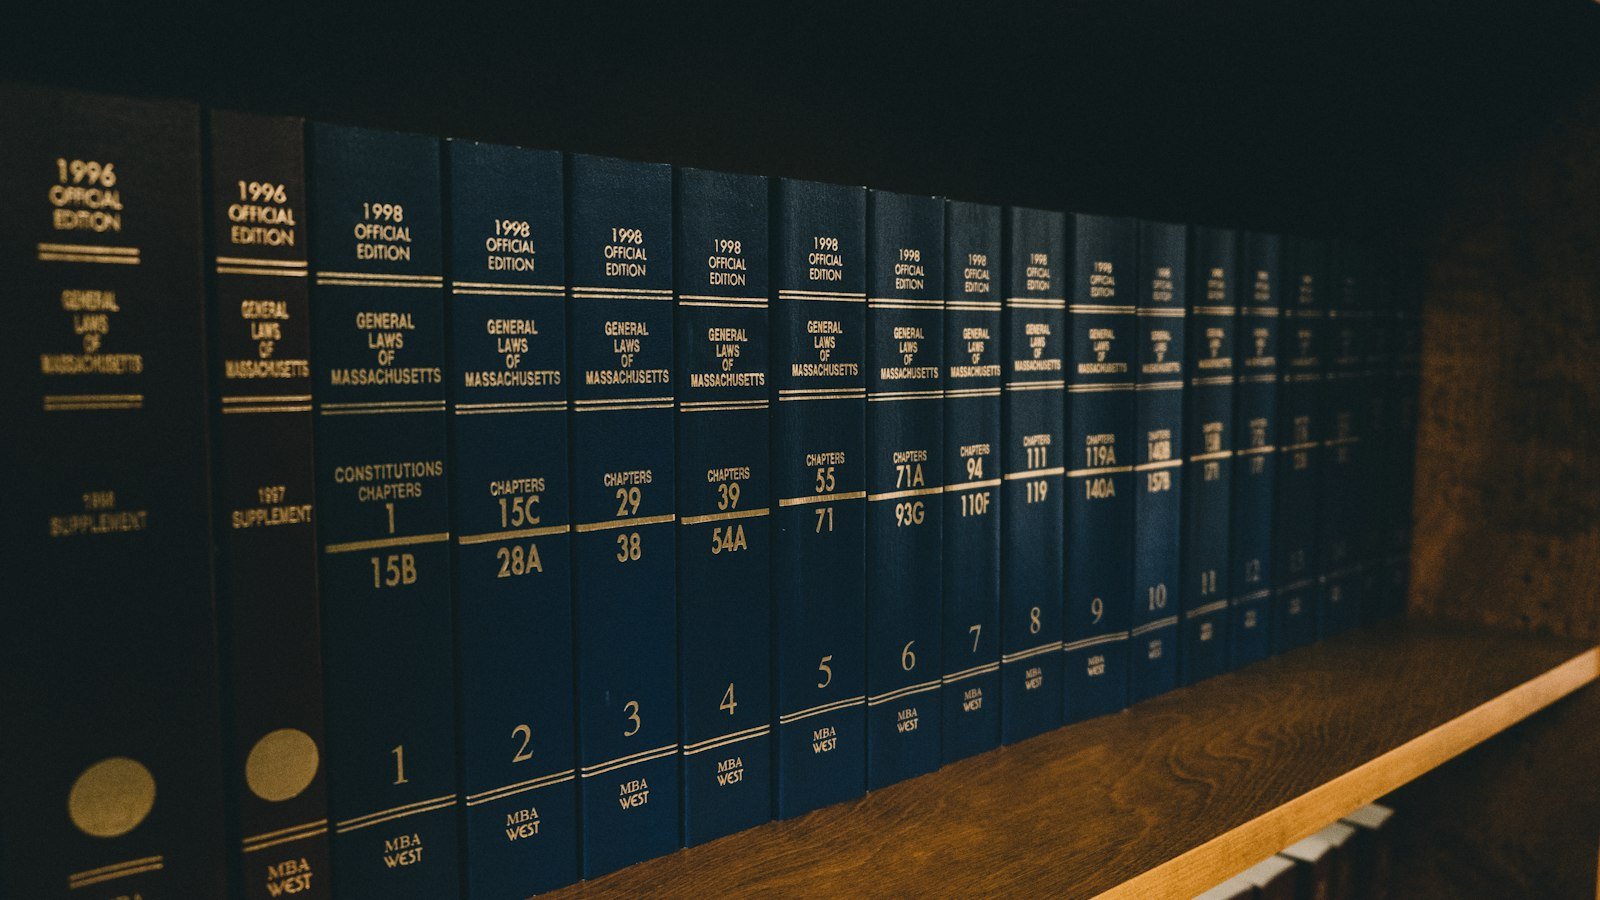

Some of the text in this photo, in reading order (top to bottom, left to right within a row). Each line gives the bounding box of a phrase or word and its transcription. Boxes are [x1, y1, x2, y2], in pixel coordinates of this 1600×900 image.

[56, 158, 116, 187] 1996
[48, 185, 123, 210] OFFICIAL
[238, 181, 287, 203] 1996
[52, 208, 122, 233] EDITION
[228, 203, 296, 226] OFFICIAL
[363, 203, 404, 222] 1998
[231, 225, 295, 247] EDITION
[354, 225, 412, 243] OFFICIAL
[494, 219, 531, 238] 1998
[611, 227, 643, 245] 1998
[356, 244, 411, 262] EDITION
[486, 237, 536, 254] OFFICIAL
[604, 245, 647, 261] OFFICIAL
[714, 239, 742, 254] 1998
[813, 237, 838, 251] 1998
[487, 255, 535, 272] EDITION
[708, 256, 747, 271] OFFICIAL
[808, 253, 843, 267] OFFICIAL
[899, 249, 921, 262] 1998
[968, 253, 987, 267] 1998
[1030, 253, 1047, 266] 1998
[605, 262, 647, 277] EDITION
[809, 267, 842, 281] EDITION
[894, 263, 925, 277] OFFICIAL
[964, 268, 990, 281] OFFICIAL
[1026, 266, 1050, 279] OFFICIAL
[709, 272, 746, 287] EDITION
[895, 277, 924, 291] EDITION
[964, 281, 989, 293] EDITION
[1026, 279, 1050, 291] EDITION
[241, 300, 290, 321] GENERAL
[251, 321, 281, 341] LAWS
[356, 312, 415, 332] GENERAL
[486, 319, 538, 335] GENERAL
[604, 321, 649, 337] GENERAL
[807, 320, 843, 335] GENERAL
[1025, 323, 1051, 336] GENERAL
[368, 332, 404, 349] LAWS
[708, 328, 748, 342] GENERAL
[814, 336, 836, 349] LAWS
[893, 327, 924, 340] GENERAL
[963, 327, 990, 340] GENERAL
[1030, 336, 1046, 349] LAWS
[259, 341, 274, 359] OF
[497, 337, 528, 353] LAWS
[613, 339, 640, 353] LAWS
[716, 344, 740, 358] LAWS
[899, 341, 918, 354] LAWS
[968, 340, 985, 353] LAWS
[1033, 348, 1042, 359] OF
[378, 349, 395, 366] OF
[505, 353, 521, 369] OF
[620, 353, 634, 368] OF
[722, 358, 734, 372] OF
[819, 349, 830, 363] OF
[903, 353, 913, 366] OF
[972, 353, 981, 365] OF
[225, 359, 310, 379] MASSACHUSETTS
[792, 363, 858, 377] MASSACHUSETTS
[880, 367, 939, 380] MASSACHUSETTS
[951, 365, 1001, 378] MASSACHUSETTS
[1014, 359, 1061, 372] MASSACHUSETTS
[331, 368, 442, 386] MASSACHUSETTS
[464, 370, 561, 388] MASSACHUSETTS
[585, 368, 670, 385] MASSACHUSETTS
[690, 372, 765, 388] MASSACHUSETTS
[1023, 434, 1051, 447] CHAPTERS
[806, 451, 845, 467] CHAPTERS
[893, 450, 928, 464] CHAPTERS
[960, 443, 990, 458] CHAPTERS
[1026, 446, 1047, 470] 111
[1086, 445, 1116, 467] 119A
[335, 460, 443, 483] CONSTITUTIONS
[604, 469, 652, 487] CHAPTERS
[707, 466, 750, 483] CHAPTERS
[895, 464, 925, 489] 71A
[966, 457, 983, 481] 94
[490, 477, 545, 497] CHAPTERS
[815, 466, 836, 493] 55
[358, 482, 422, 502] CHAPTERS
[717, 482, 741, 511] 39
[1026, 480, 1048, 504] 119
[1085, 478, 1116, 500] 140A
[616, 486, 642, 516] 29
[960, 492, 990, 518] 110F
[232, 504, 313, 529] SUPPLEMENT
[385, 503, 396, 533] 1
[498, 495, 541, 528] 15C
[815, 507, 833, 534] 71
[895, 501, 925, 528] 93G
[616, 532, 642, 563] 38
[711, 524, 747, 555] 54A
[496, 543, 543, 578] 28A
[370, 553, 418, 588] 15B
[1201, 569, 1216, 595] 11
[1148, 583, 1167, 611] 10
[1091, 597, 1103, 624] 9
[1029, 606, 1041, 634] 8
[968, 624, 982, 653] 7
[901, 640, 916, 672] 6
[817, 655, 833, 689] 5
[1026, 667, 1042, 680] MBA
[1025, 677, 1043, 690] WEST
[719, 682, 738, 715] 4
[964, 688, 982, 700] MBA
[963, 697, 983, 712] WEST
[623, 700, 642, 737] 3
[897, 707, 918, 722] MBA
[813, 726, 836, 742] MBA
[897, 718, 919, 734] WEST
[511, 724, 534, 763] 2
[812, 737, 837, 754] WEST
[391, 744, 409, 785] 1
[717, 756, 743, 774] MBA
[717, 768, 744, 787] WEST
[620, 778, 648, 796] MBA
[619, 790, 650, 810] WEST
[506, 807, 539, 827] MBA
[505, 819, 541, 842] WEST
[385, 833, 422, 854] MBA
[384, 847, 423, 869] WEST
[268, 858, 312, 882] MBA
[266, 873, 313, 897] WEST
